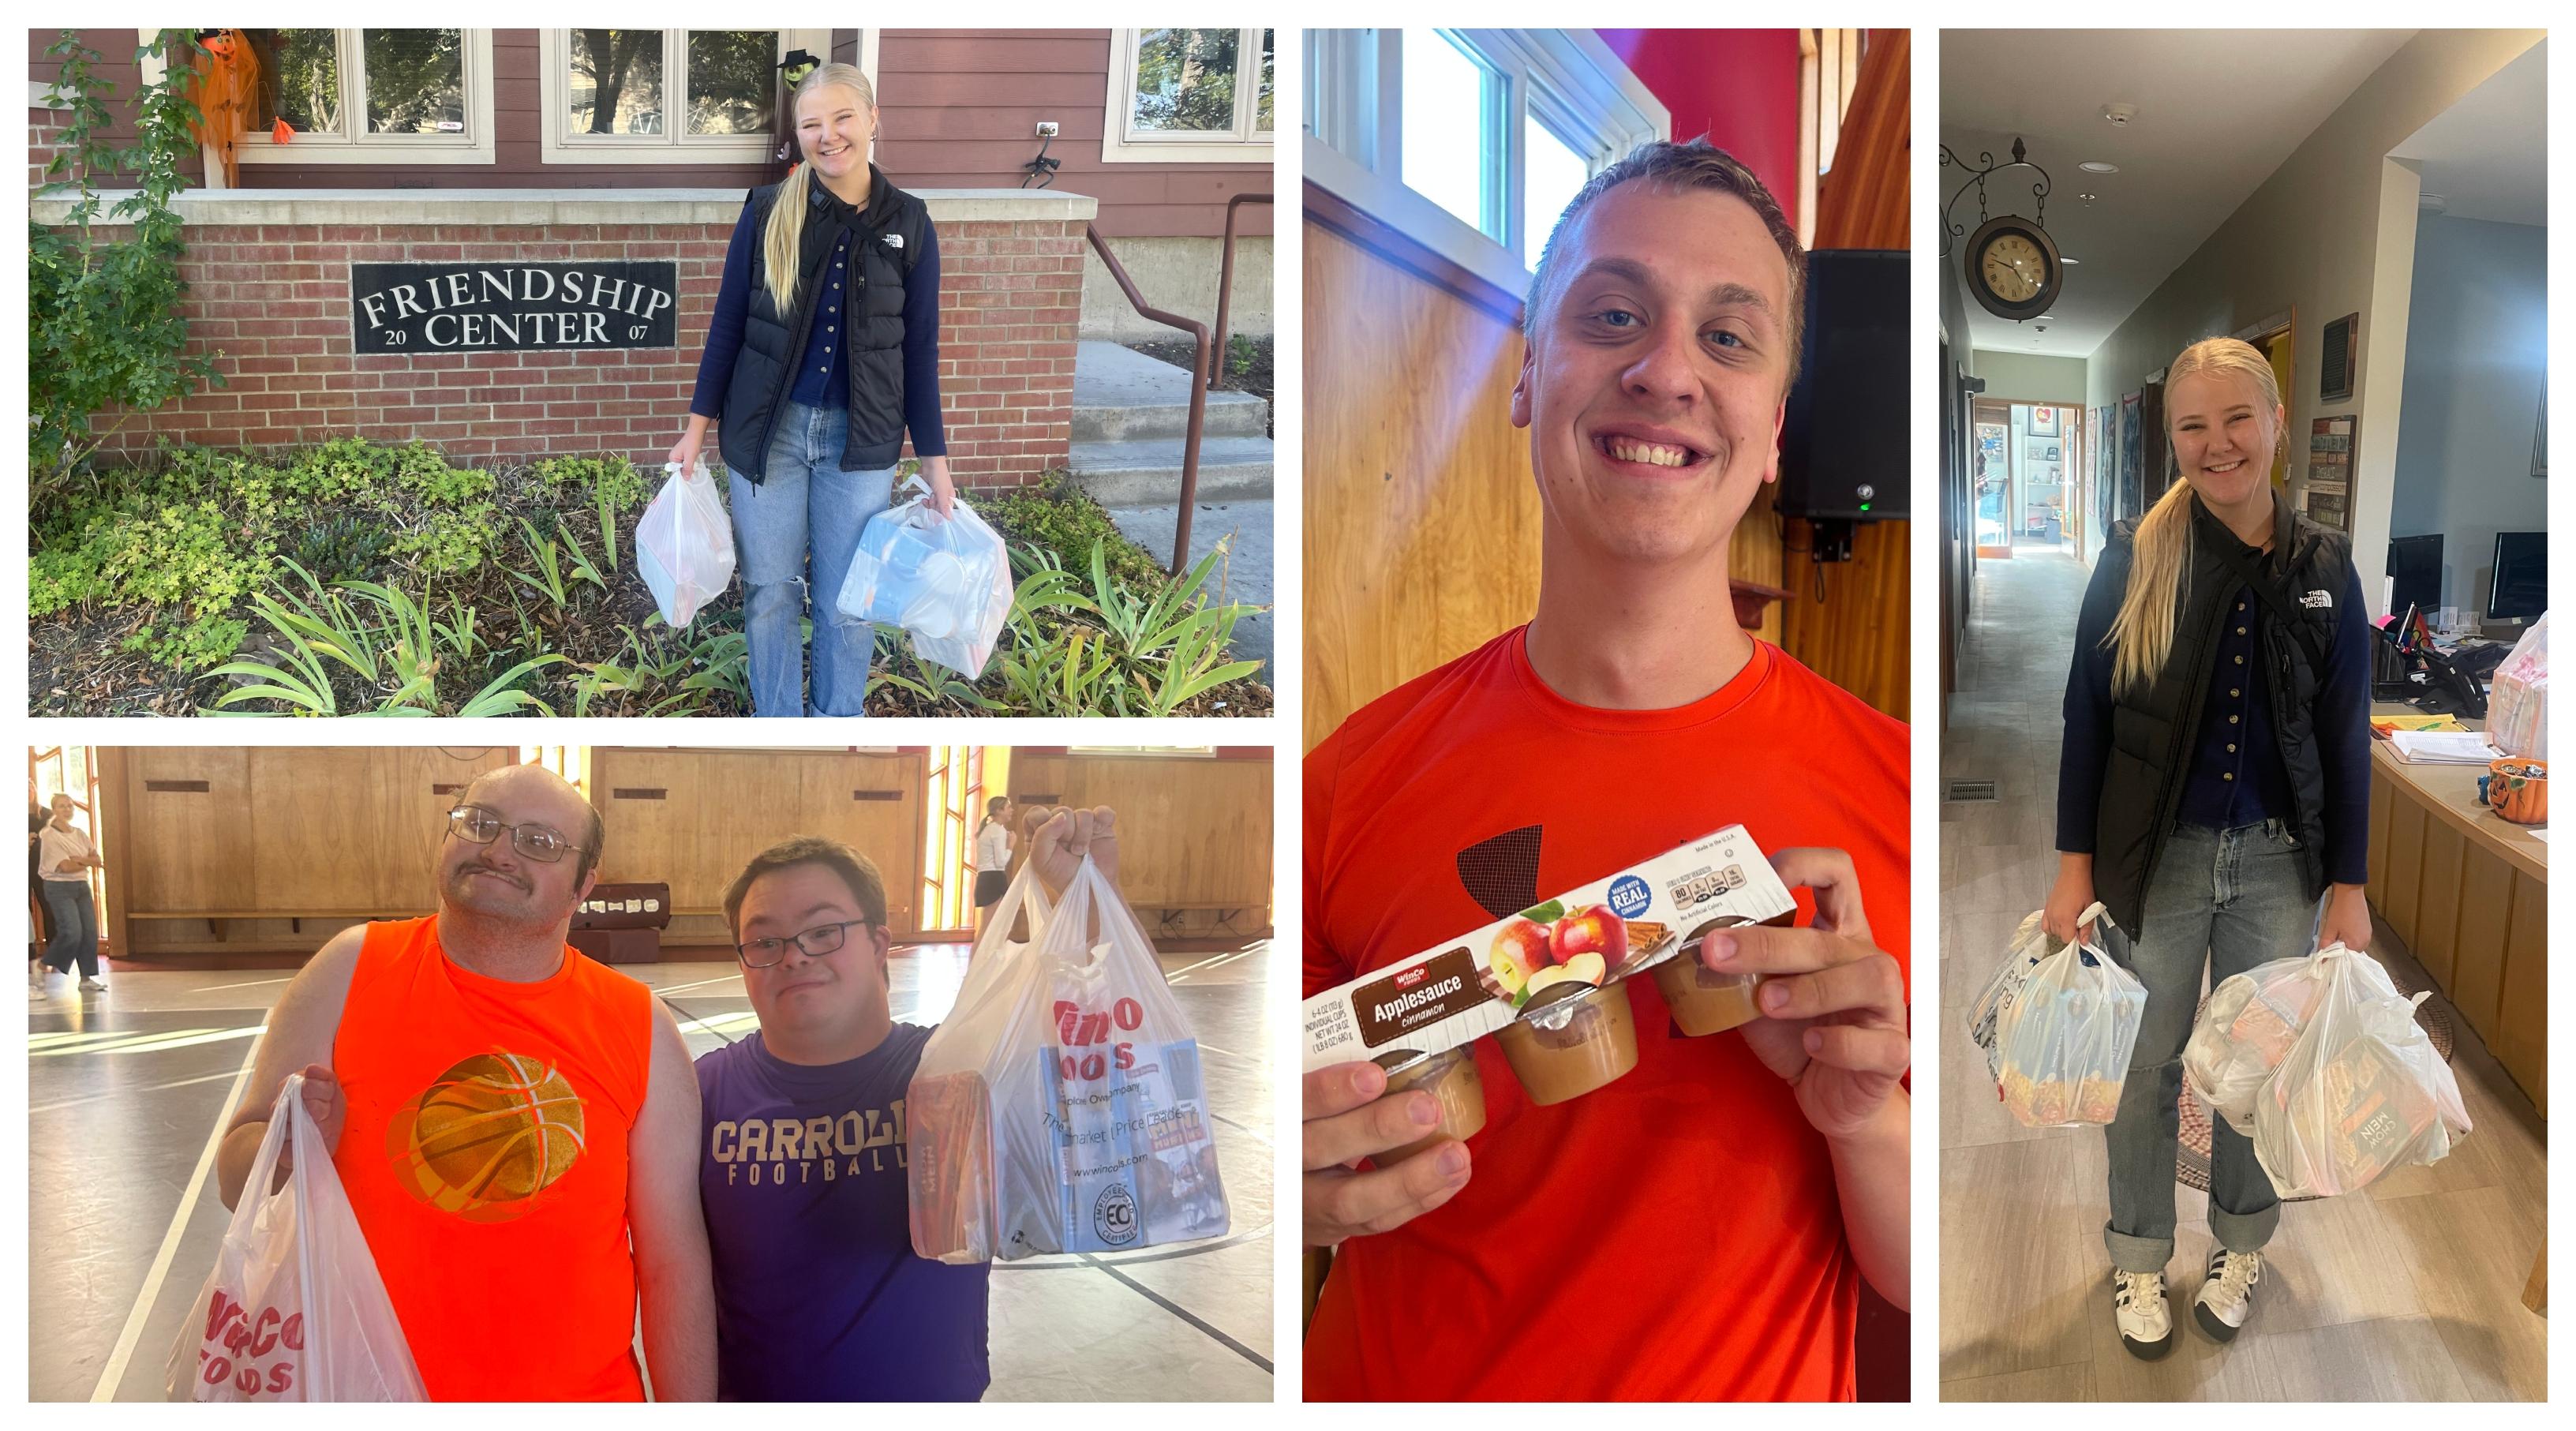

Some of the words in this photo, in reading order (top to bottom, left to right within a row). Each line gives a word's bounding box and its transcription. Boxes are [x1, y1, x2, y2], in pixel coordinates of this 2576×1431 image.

[358, 268, 672, 329] FRIENDSHIP
[384, 330, 406, 346] 20
[425, 312, 612, 347] CENTER
[628, 324, 649, 340] 07
[1612, 884, 1627, 895] MADE
[1626, 879, 1640, 889] WITH
[1612, 886, 1648, 910] REAL
[1676, 887, 1687, 899] 80
[1687, 905, 1708, 916] Artificial
[1707, 901, 1723, 910] Colors
[1396, 967, 1425, 984] WinCo
[1320, 1004, 1328, 1014] OZ
[1374, 976, 1462, 1023] Applesauce
[1305, 1014, 1333, 1032] INDIVIDUAL
[1333, 1009, 1346, 1021] CUPS
[1401, 1002, 1445, 1028] cinnamon
[1315, 1028, 1326, 1040] NET
[1325, 1025, 1335, 1036] WT
[1335, 1022, 1342, 1032] 24
[1342, 1019, 1350, 1029] OZ
[1328, 1036, 1338, 1047] OZ)
[1338, 1032, 1349, 1043] 680
[1116, 1118, 1144, 1137] Price
[2360, 1111, 2389, 1141] MEIN
[2368, 1120, 2396, 1150] CHOW
[728, 1146, 908, 1186] FOOTBALL
